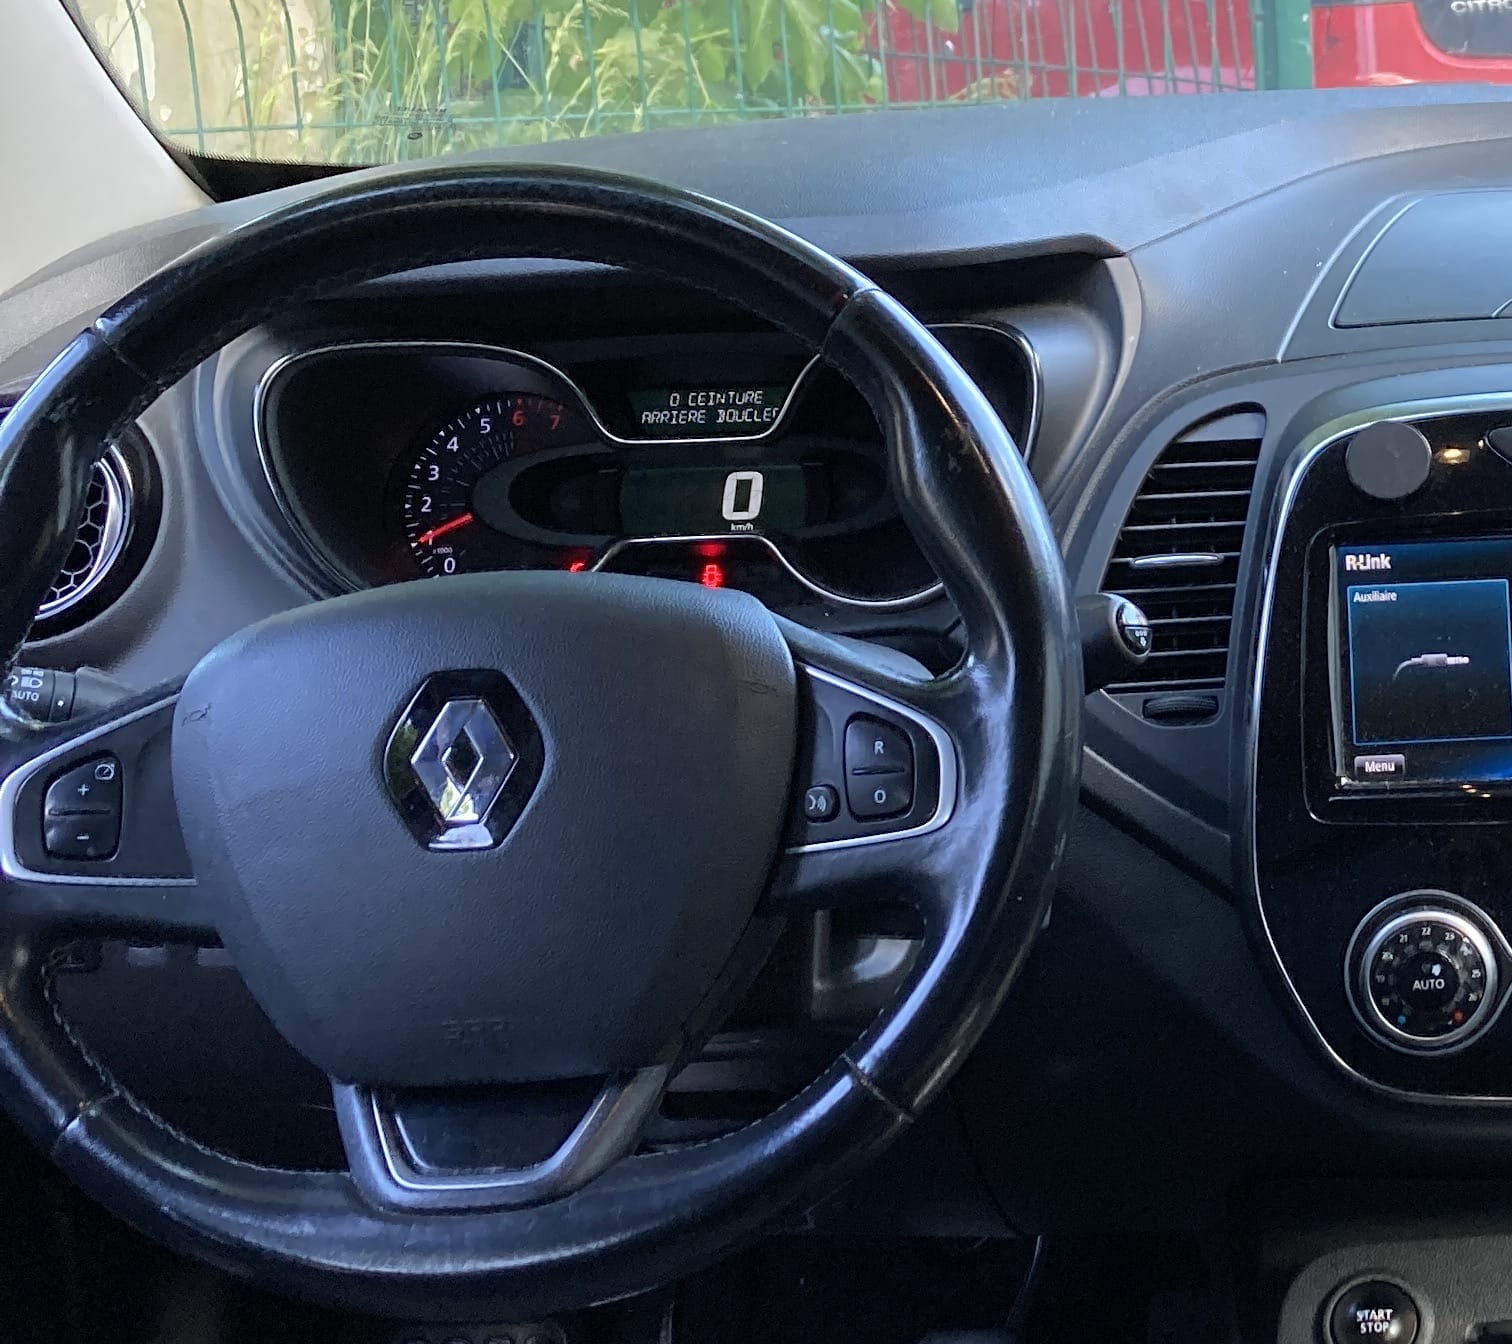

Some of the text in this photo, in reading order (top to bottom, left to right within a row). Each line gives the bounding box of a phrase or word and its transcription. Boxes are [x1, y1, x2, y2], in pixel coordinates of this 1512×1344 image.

[688, 390, 763, 406] CEINTURE
[512, 411, 524, 426] 6
[551, 415, 561, 430] 7
[641, 409, 707, 424] ARRIERE
[479, 418, 491, 434] 5
[446, 436, 459, 452] 4
[428, 465, 440, 481] 3
[723, 471, 763, 520] 0
[420, 496, 432, 512] 2
[730, 522, 754, 531] km/h
[444, 557, 456, 573] 0
[1353, 590, 1398, 603] Auxiliaire
[13, 690, 39, 701] AUTO
[874, 740, 884, 754] R
[1364, 760, 1396, 773] Menu
[1421, 926, 1432, 936] 22
[1399, 934, 1408, 944] 21
[1412, 978, 1446, 991] AUTO
[1356, 1309, 1393, 1323] START
[1360, 1321, 1390, 1335] STOP
